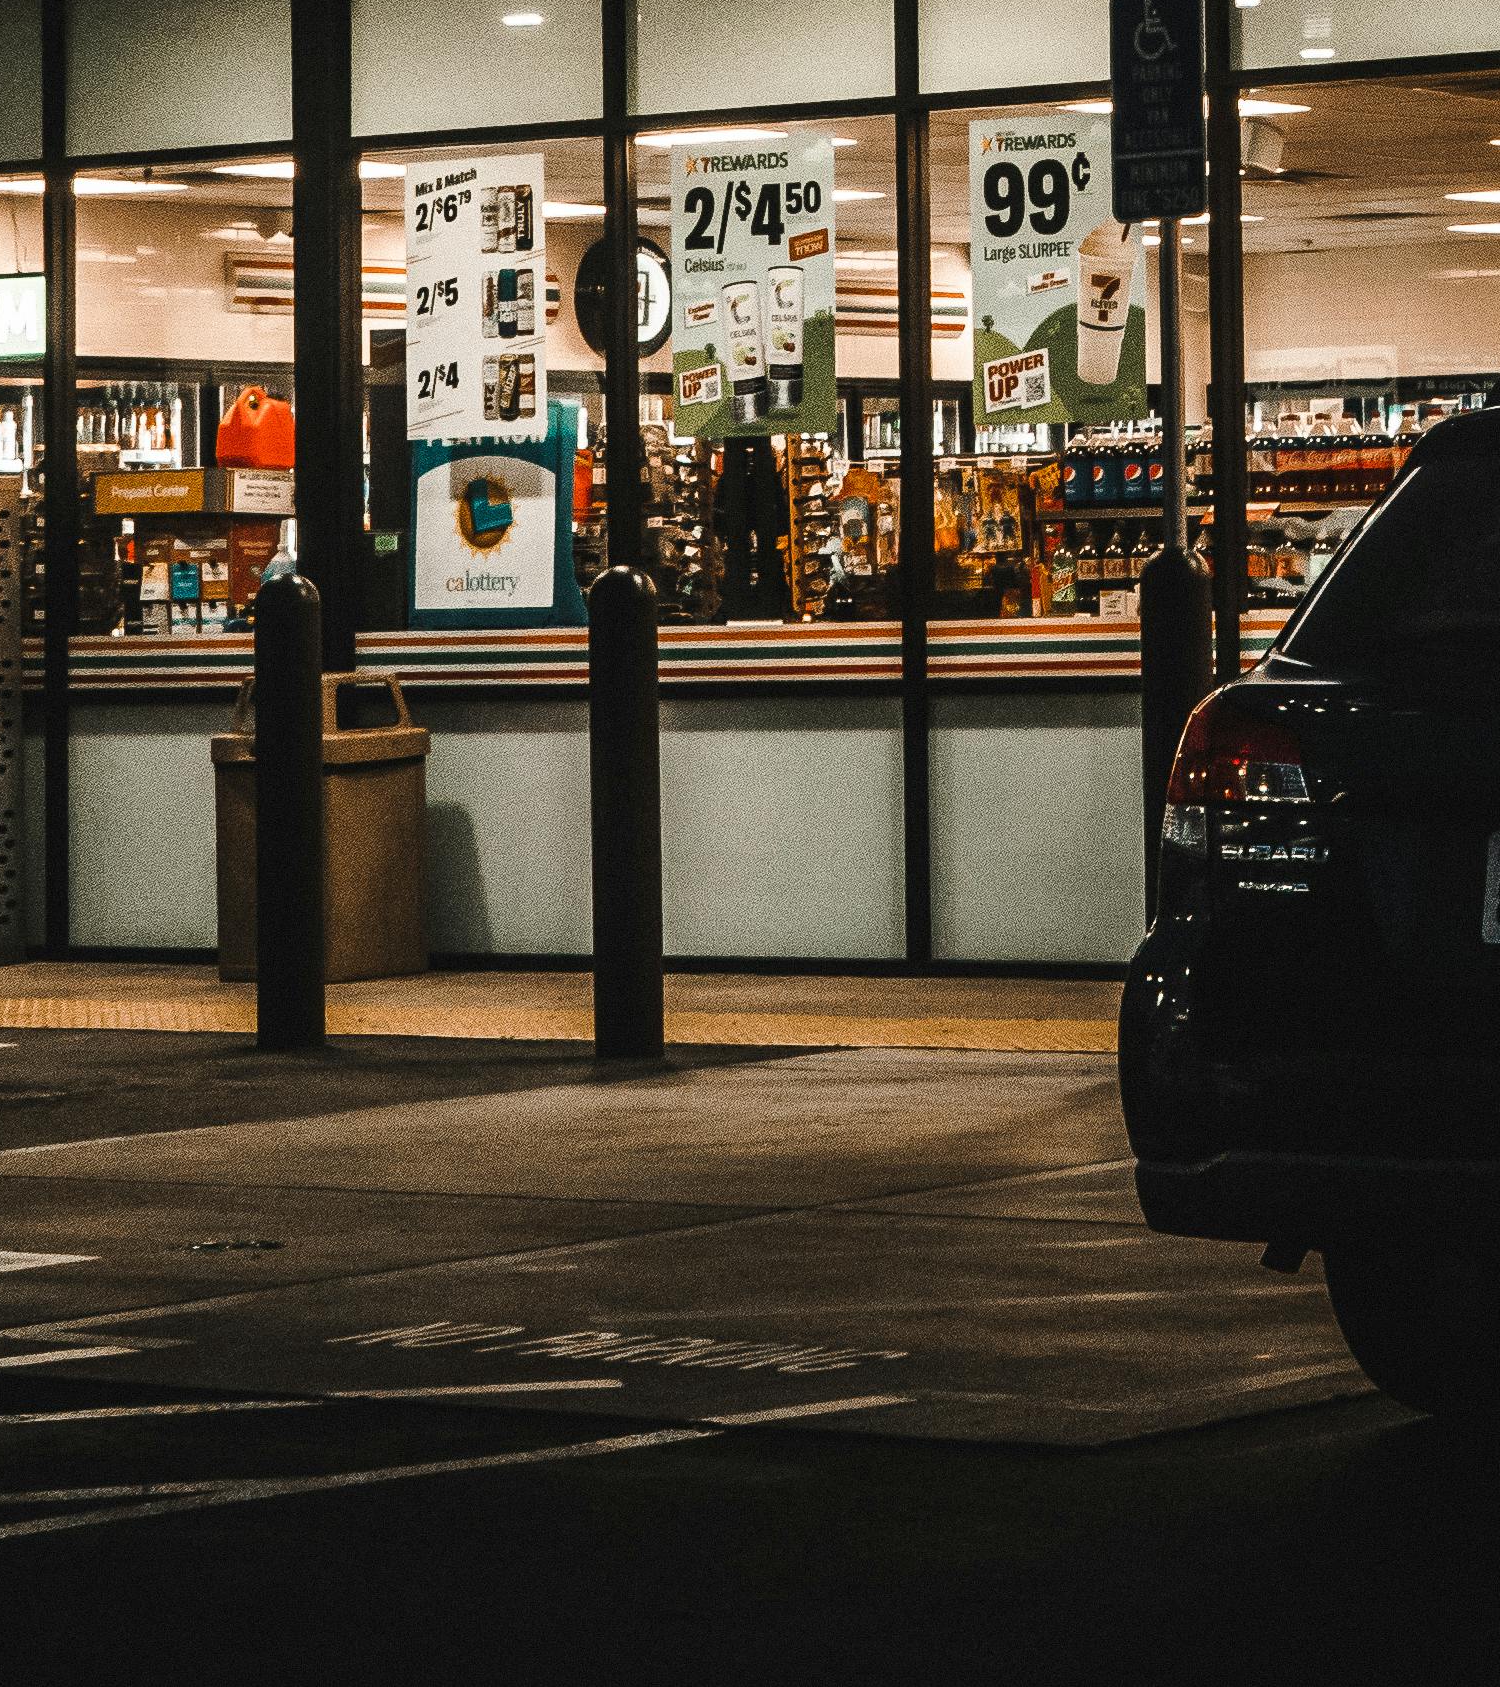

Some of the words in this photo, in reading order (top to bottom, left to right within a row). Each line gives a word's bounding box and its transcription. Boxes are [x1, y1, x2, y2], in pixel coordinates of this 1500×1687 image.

[415, 182, 435, 197] Mix
[436, 177, 443, 191] &
[444, 168, 477, 187] Match
[684, 257, 725, 275] Celsius
[984, 245, 1016, 264] Large
[1018, 241, 1071, 260] SLURPEE
[416, 277, 459, 316] 2/$5
[988, 353, 1045, 380] POWER
[417, 361, 460, 400] 2/$4
[683, 381, 702, 399] UP
[989, 376, 1019, 403] UP
[111, 485, 154, 500] Prepaid
[154, 483, 190, 498] Center
[445, 570, 520, 597] calottery
[1221, 844, 1330, 862] SUBARU
[325, 1321, 525, 1348] NO
[473, 1331, 909, 1374] PARKING
